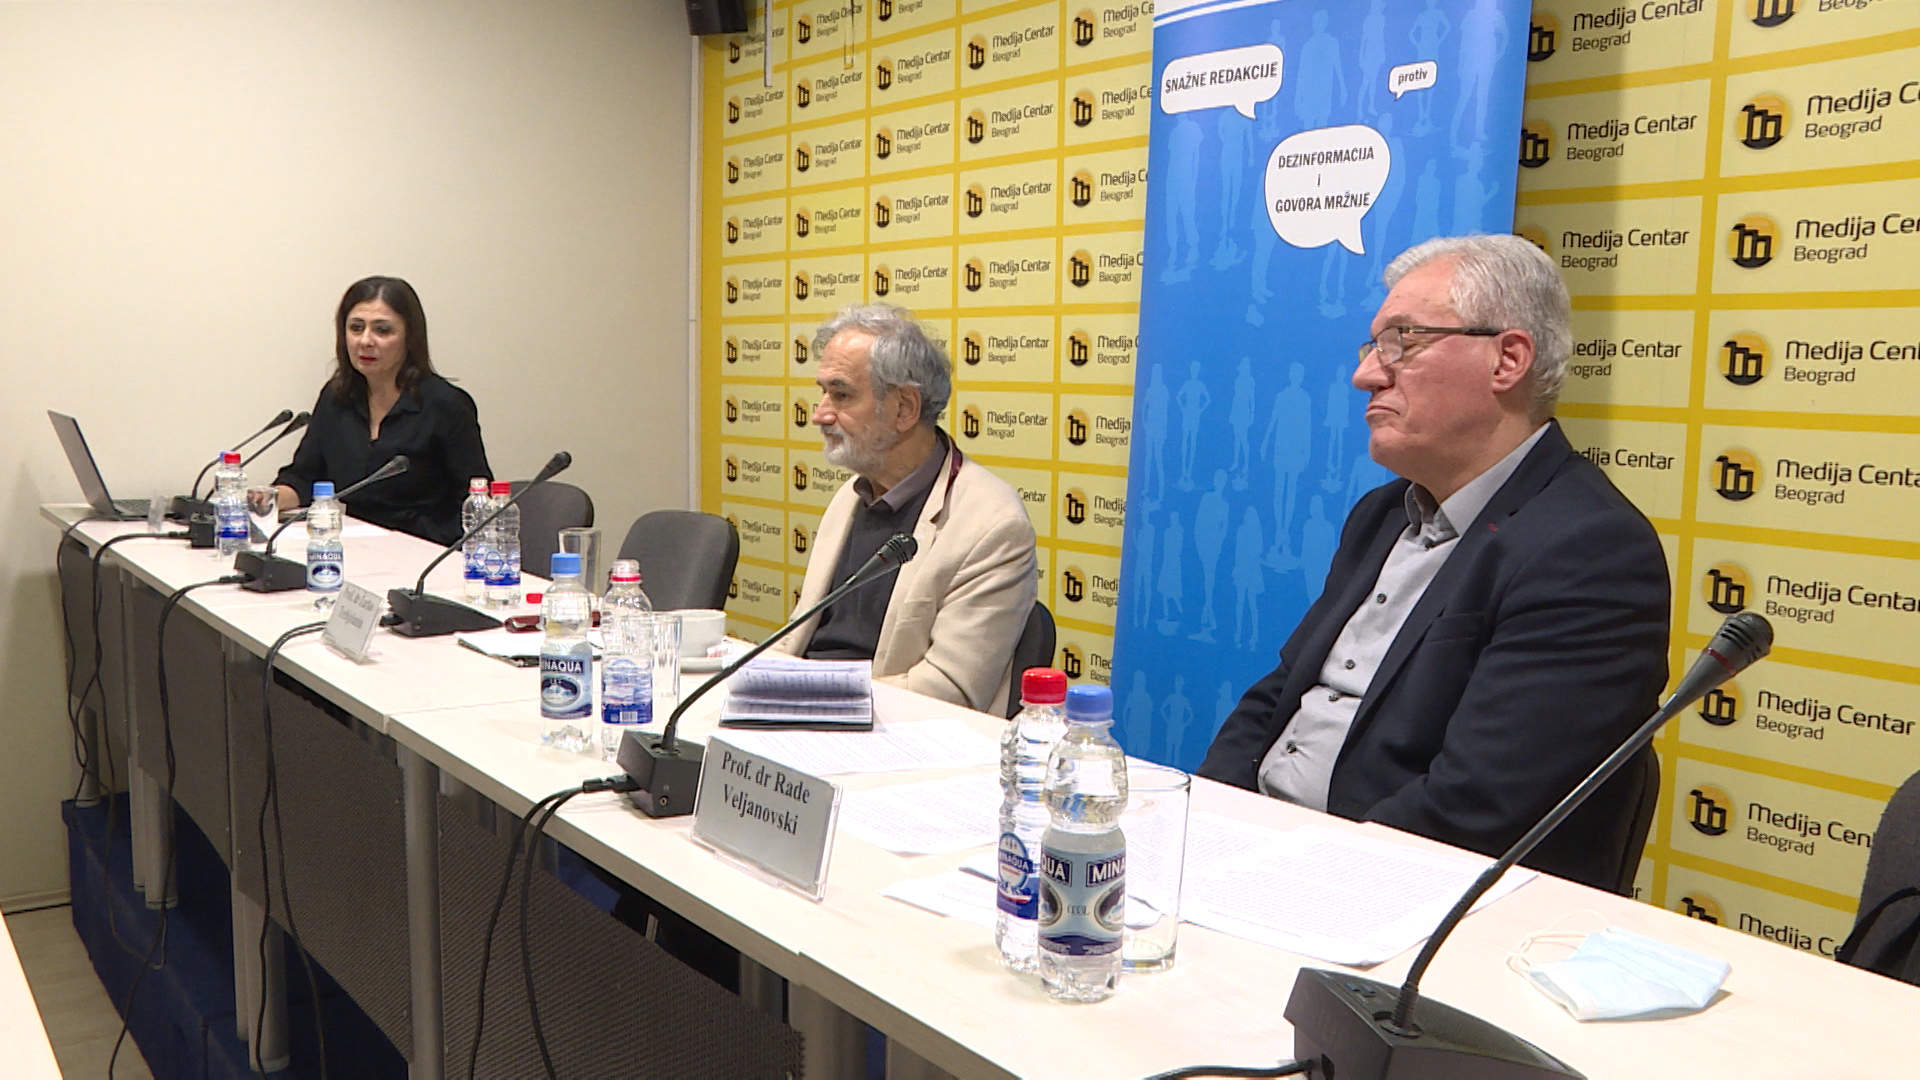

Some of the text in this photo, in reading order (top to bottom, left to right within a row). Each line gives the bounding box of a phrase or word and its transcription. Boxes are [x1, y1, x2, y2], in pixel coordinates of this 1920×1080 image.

[1104, 7, 1139, 23] Medija
[1573, 9, 1636, 31] Medija
[992, 25, 1055, 49] Medija Centar
[1572, 30, 1631, 52] Beograd
[1165, 71, 1207, 94] SNAŽNE
[1209, 61, 1278, 87] REDAKCIJE
[1398, 68, 1428, 86] protiv
[1102, 91, 1137, 106] Medija
[1806, 87, 1891, 117] Medija
[991, 104, 1053, 124] Medija Centar
[1567, 113, 1698, 140] Medija Centar
[1804, 114, 1883, 139] Beograd
[1278, 146, 1374, 169] DEZINFORMACIJA
[1566, 143, 1624, 161] Beograd
[990, 181, 1052, 199] Medija Centar
[1100, 171, 1136, 187] Medija
[1317, 173, 1321, 188] i
[1275, 191, 1370, 214] GOVORA MRŽNJE
[1562, 228, 1690, 251] Medija Centar
[1795, 216, 1876, 243] Medija
[1099, 253, 1134, 268] Medija
[1561, 254, 1618, 270] Beograd
[1793, 244, 1867, 264] Beograd
[989, 259, 1051, 274] Medija Centar
[988, 336, 1050, 351] Medija Centar
[1098, 335, 1132, 351] Medija
[1572, 339, 1683, 360] edija Centar
[1785, 339, 1920, 365] Medija Cen
[1784, 366, 1856, 385] Beograd
[987, 411, 1048, 426] Medija Centar
[1096, 415, 1131, 433] Medija
[1615, 449, 1675, 470] Centar
[1776, 458, 1852, 487] Medija
[1774, 484, 1845, 506] Beograd
[1767, 575, 1920, 613] Medija Centa
[1765, 600, 1835, 624] Beograd
[1757, 689, 1916, 736] Medija Centar
[1756, 714, 1824, 740] Beograd
[722, 751, 810, 804] Prof. dr Rade
[723, 783, 799, 835] Veljanovski
[1749, 803, 1874, 848] Medija Cen
[1747, 826, 1815, 856] Beograd
[1739, 912, 1812, 951] Medija
